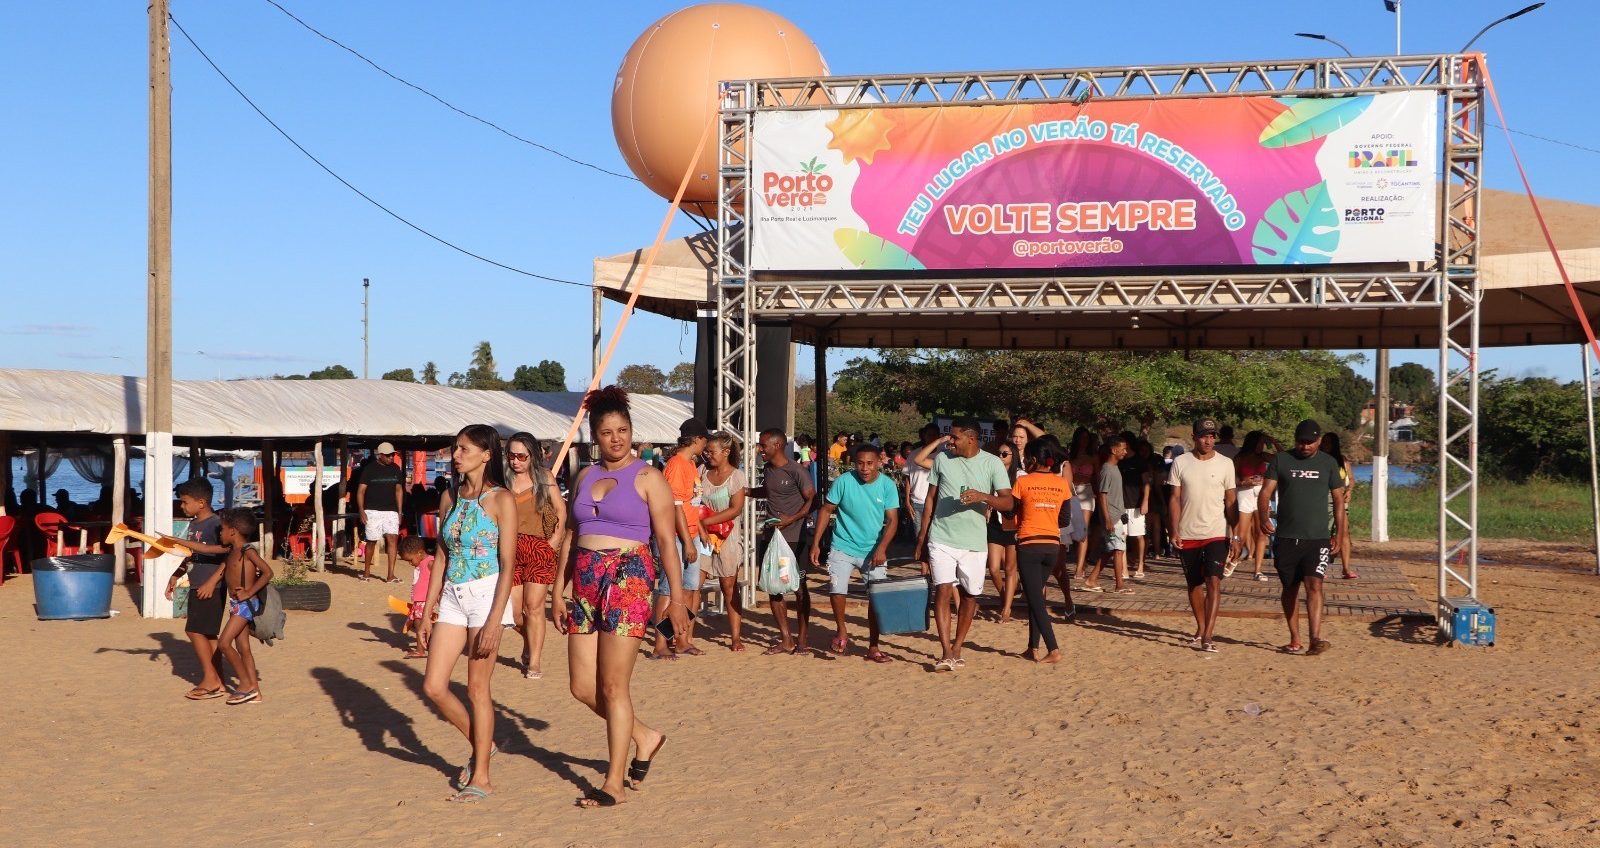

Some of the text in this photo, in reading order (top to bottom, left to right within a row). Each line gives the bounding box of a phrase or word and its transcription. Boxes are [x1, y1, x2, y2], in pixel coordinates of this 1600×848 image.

[1348, 150, 1418, 168] BRASIL
[763, 171, 833, 193] Porto
[897, 116, 1247, 237] TEU LUGAR NO VERÃO TÁ RESERVADO
[764, 189, 827, 207] verão
[944, 199, 1196, 235] VOLTE SEMPRE
[1345, 207, 1385, 216] PORTO
[1013, 237, 1124, 258] @portoverão
